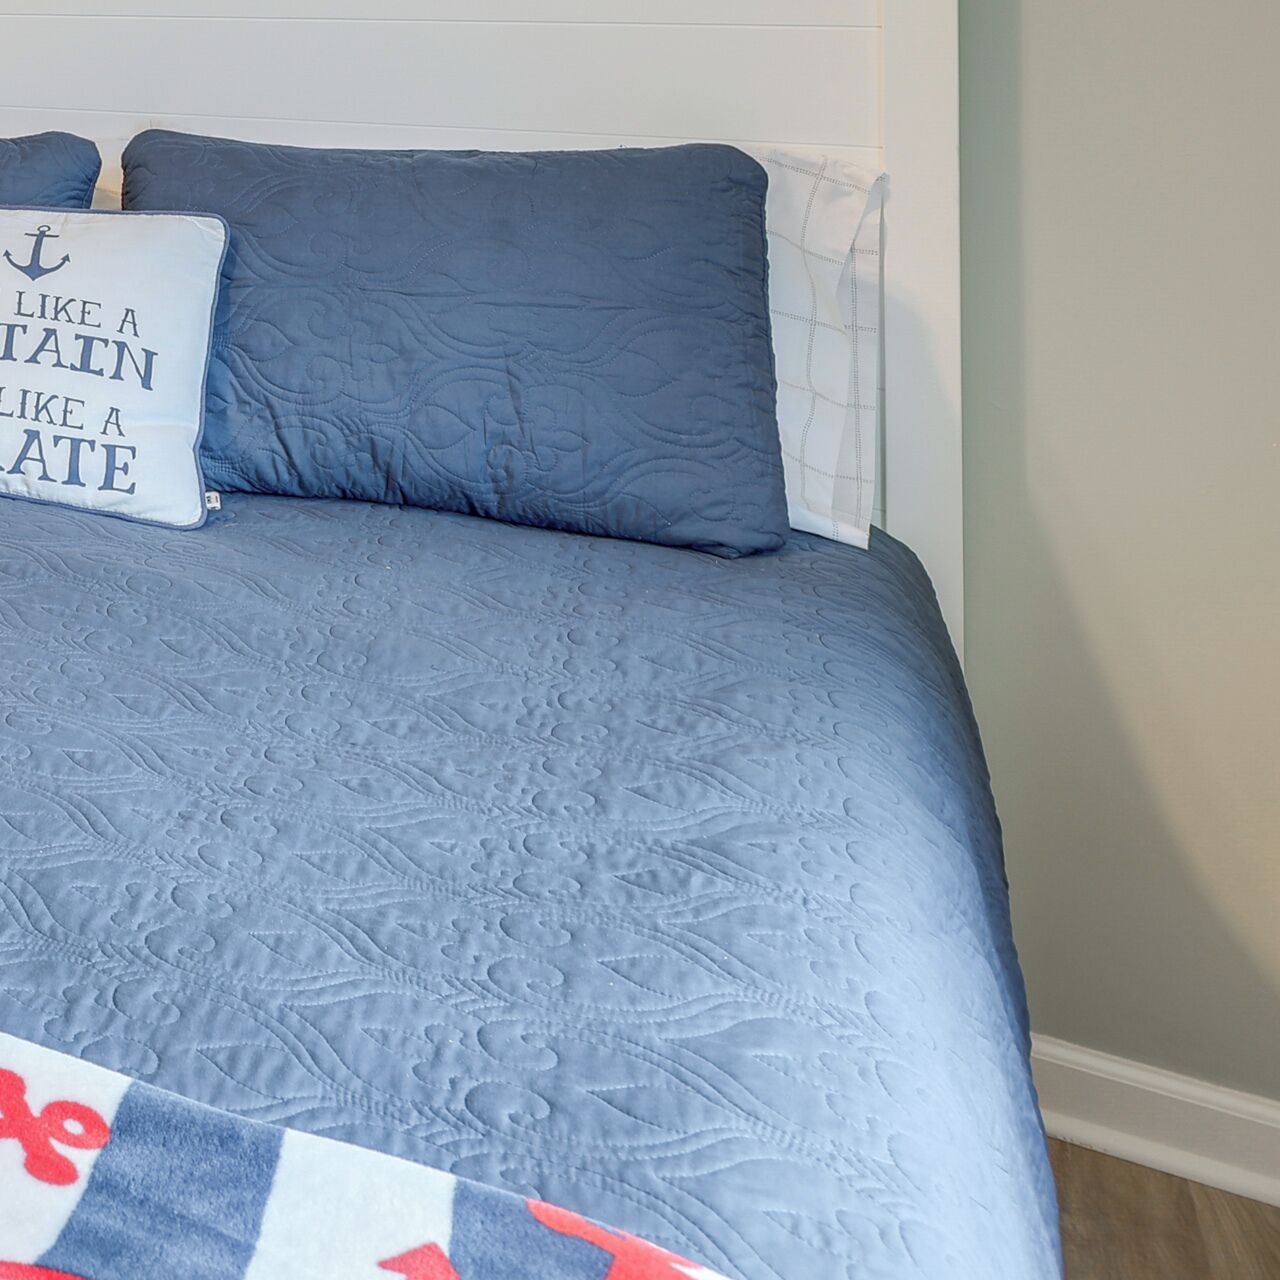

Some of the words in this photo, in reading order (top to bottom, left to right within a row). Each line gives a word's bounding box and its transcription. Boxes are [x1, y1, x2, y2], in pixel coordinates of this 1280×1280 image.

[14, 290, 103, 327] LIKE
[117, 307, 141, 338] A
[100, 407, 126, 437] A
